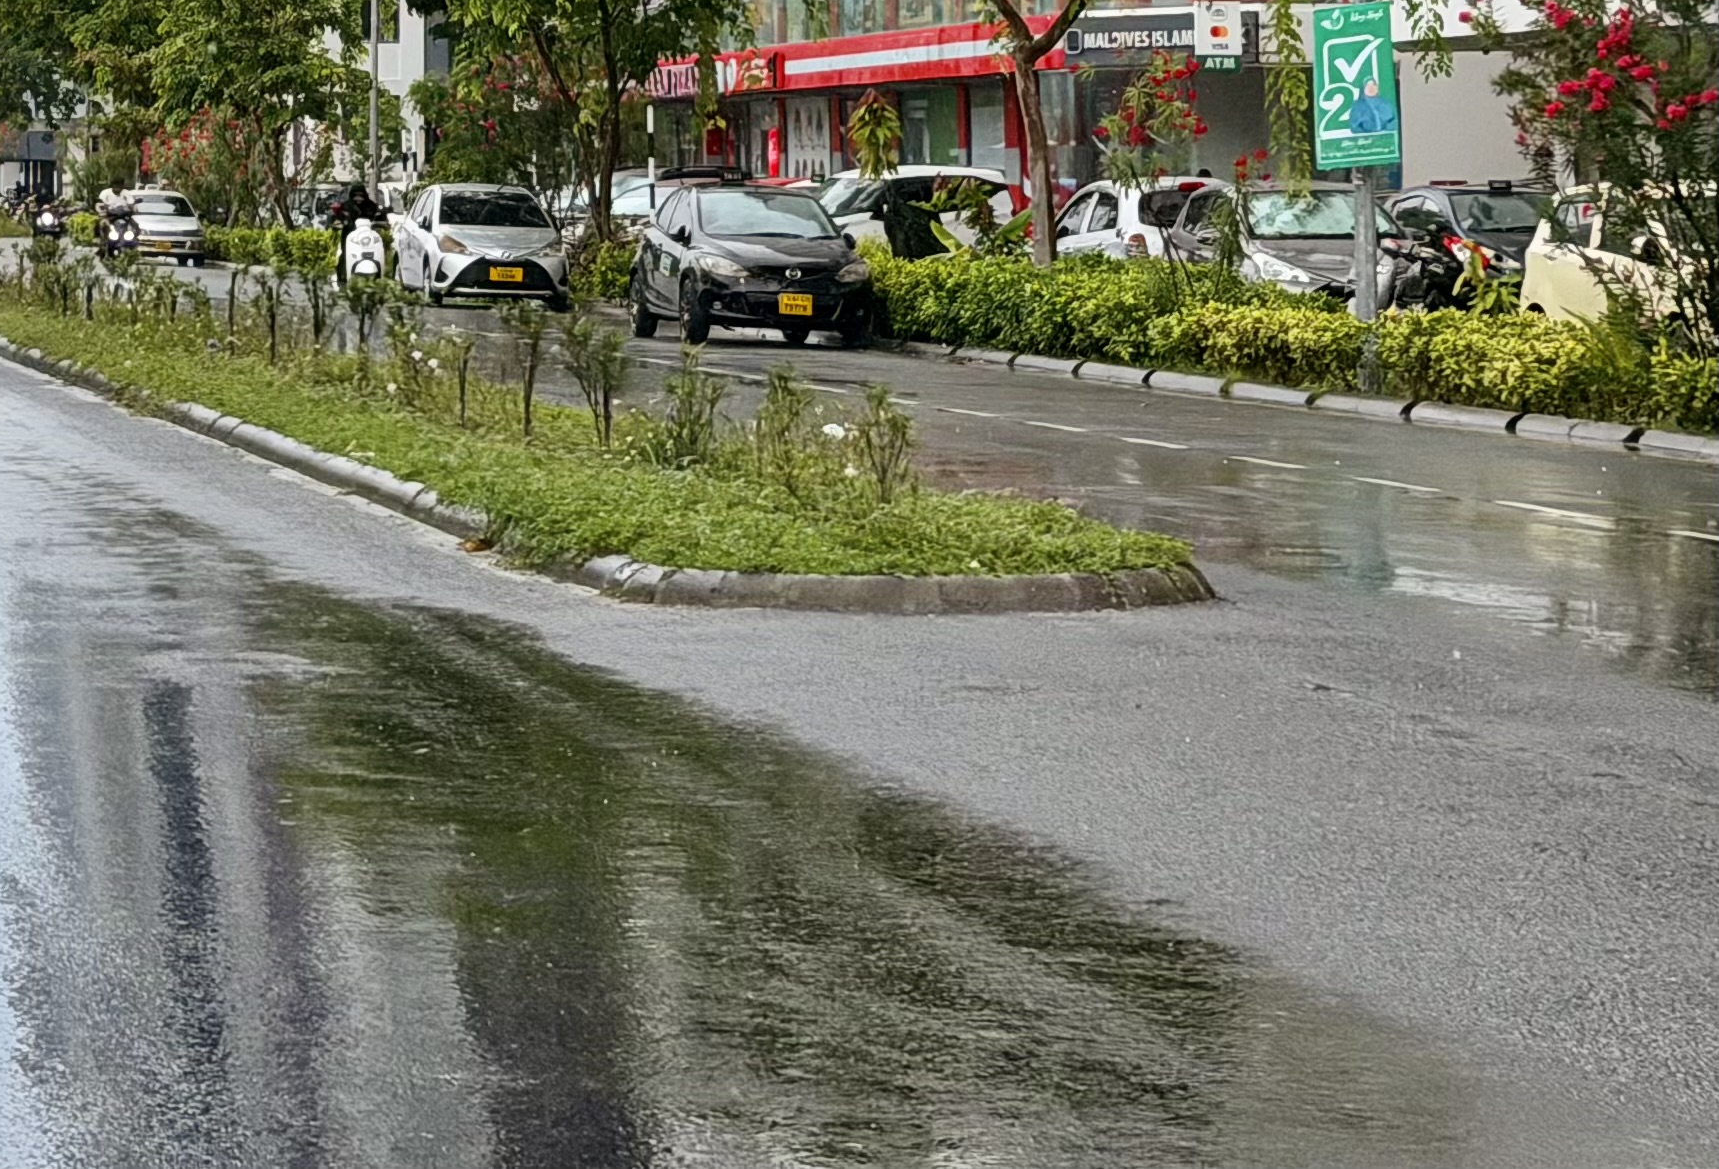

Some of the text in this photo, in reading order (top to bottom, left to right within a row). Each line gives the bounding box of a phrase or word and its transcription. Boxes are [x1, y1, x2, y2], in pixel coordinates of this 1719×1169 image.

[1084, 30, 1194, 49] MALDIVES ISLAM
[1204, 56, 1236, 70] ATM
